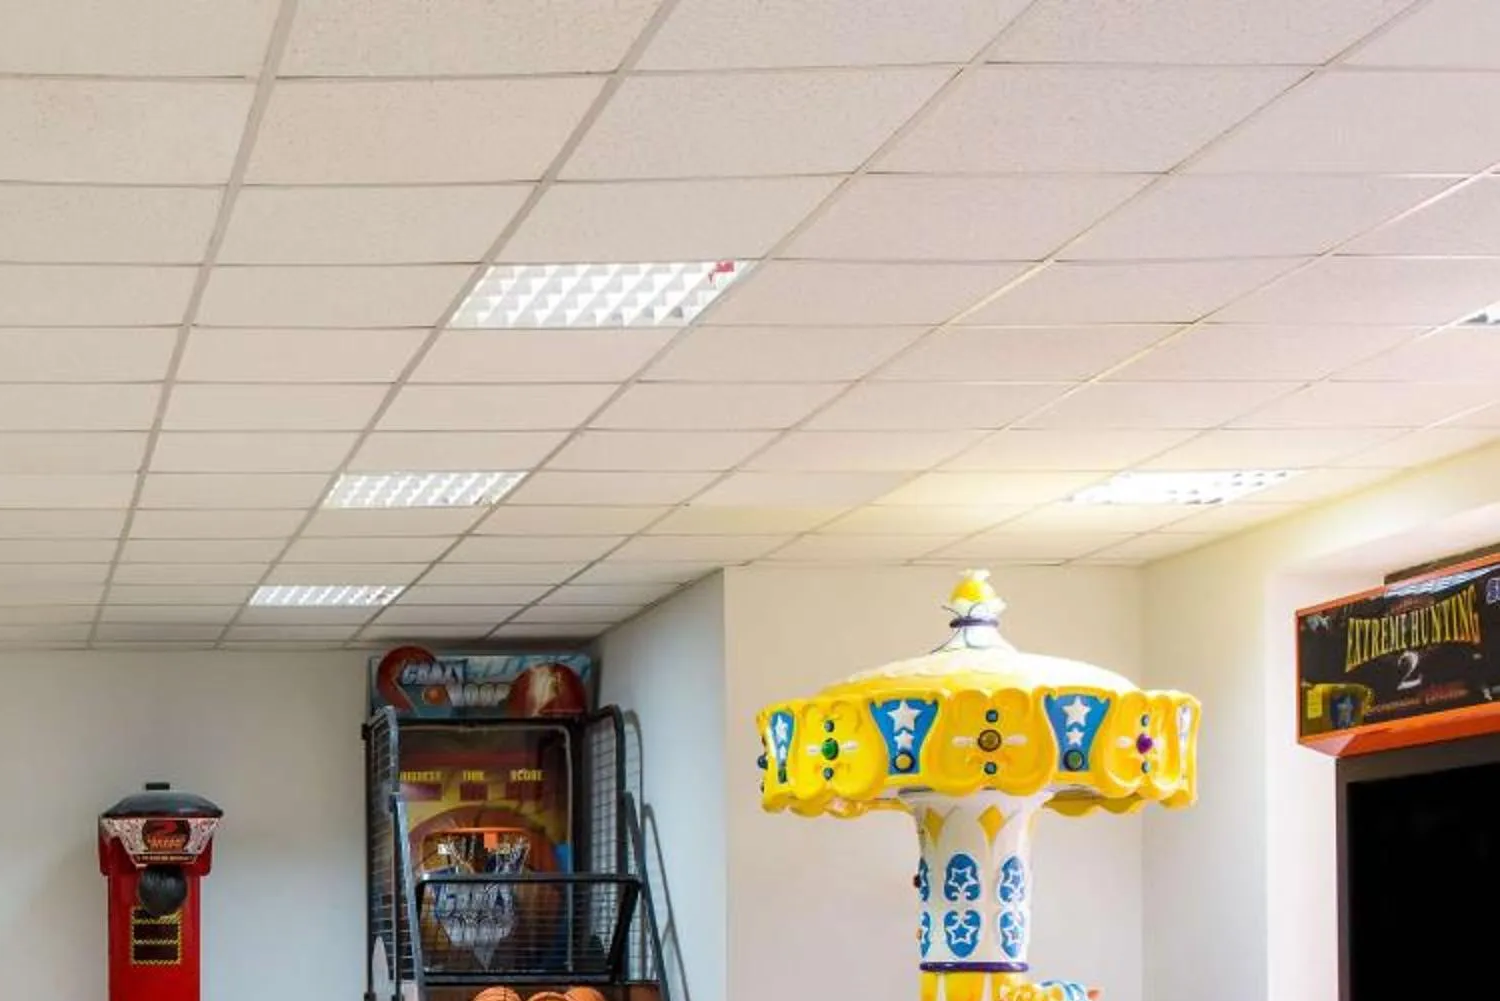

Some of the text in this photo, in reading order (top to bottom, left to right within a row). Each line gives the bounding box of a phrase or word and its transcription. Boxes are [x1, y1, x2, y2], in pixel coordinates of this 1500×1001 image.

[1345, 583, 1482, 673] EXTREME HUNTING
[1397, 650, 1422, 691] 2
